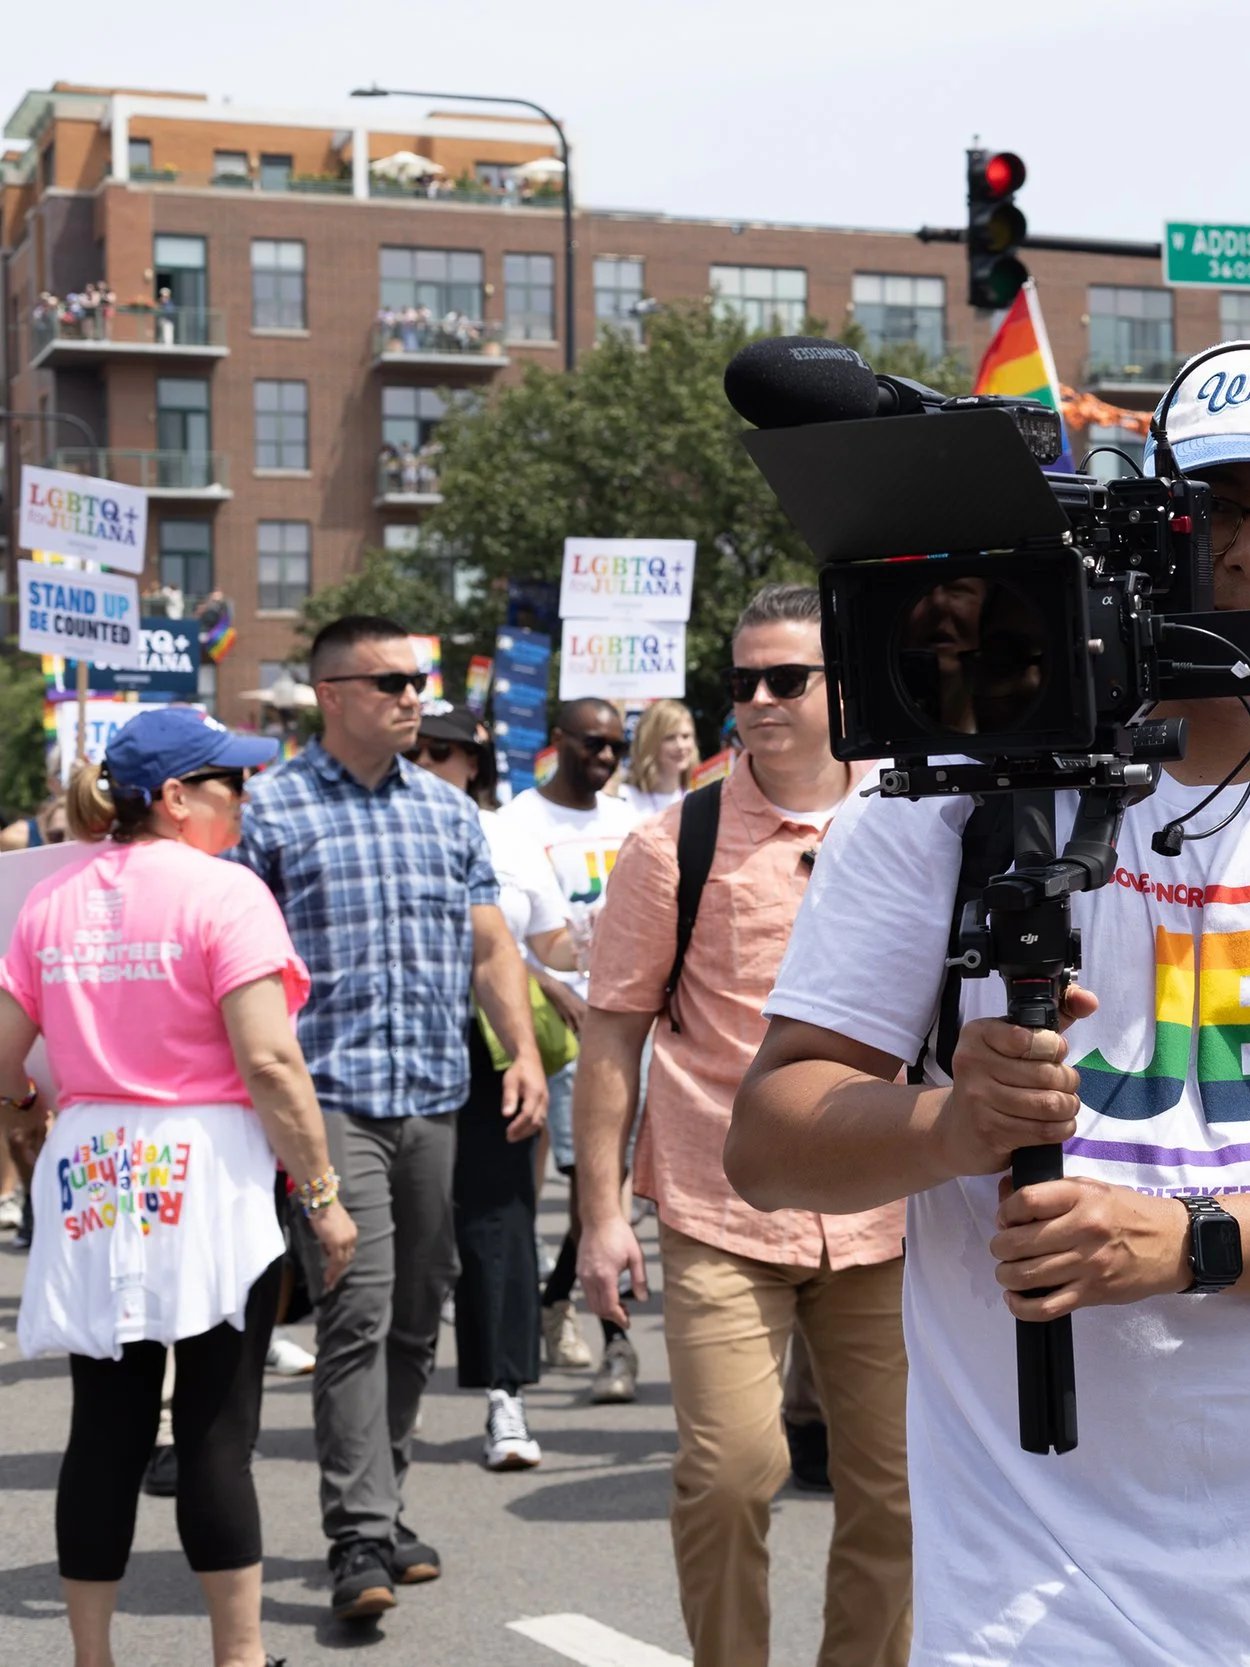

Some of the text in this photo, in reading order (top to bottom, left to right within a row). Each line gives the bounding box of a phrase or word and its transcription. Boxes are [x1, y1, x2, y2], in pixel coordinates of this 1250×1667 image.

[29, 483, 139, 525] LGBTQ+
[47, 508, 137, 546] JULIANA
[572, 554, 686, 578] LGBTQ+
[28, 581, 130, 620] STAND UP
[592, 578, 683, 596] JULIANA
[29, 610, 131, 646] BE COUNTED
[570, 635, 676, 656] LGBTQ+
[586, 659, 677, 675] JULIANA
[570, 850, 620, 904] J
[1108, 867, 1204, 908] OVENOR
